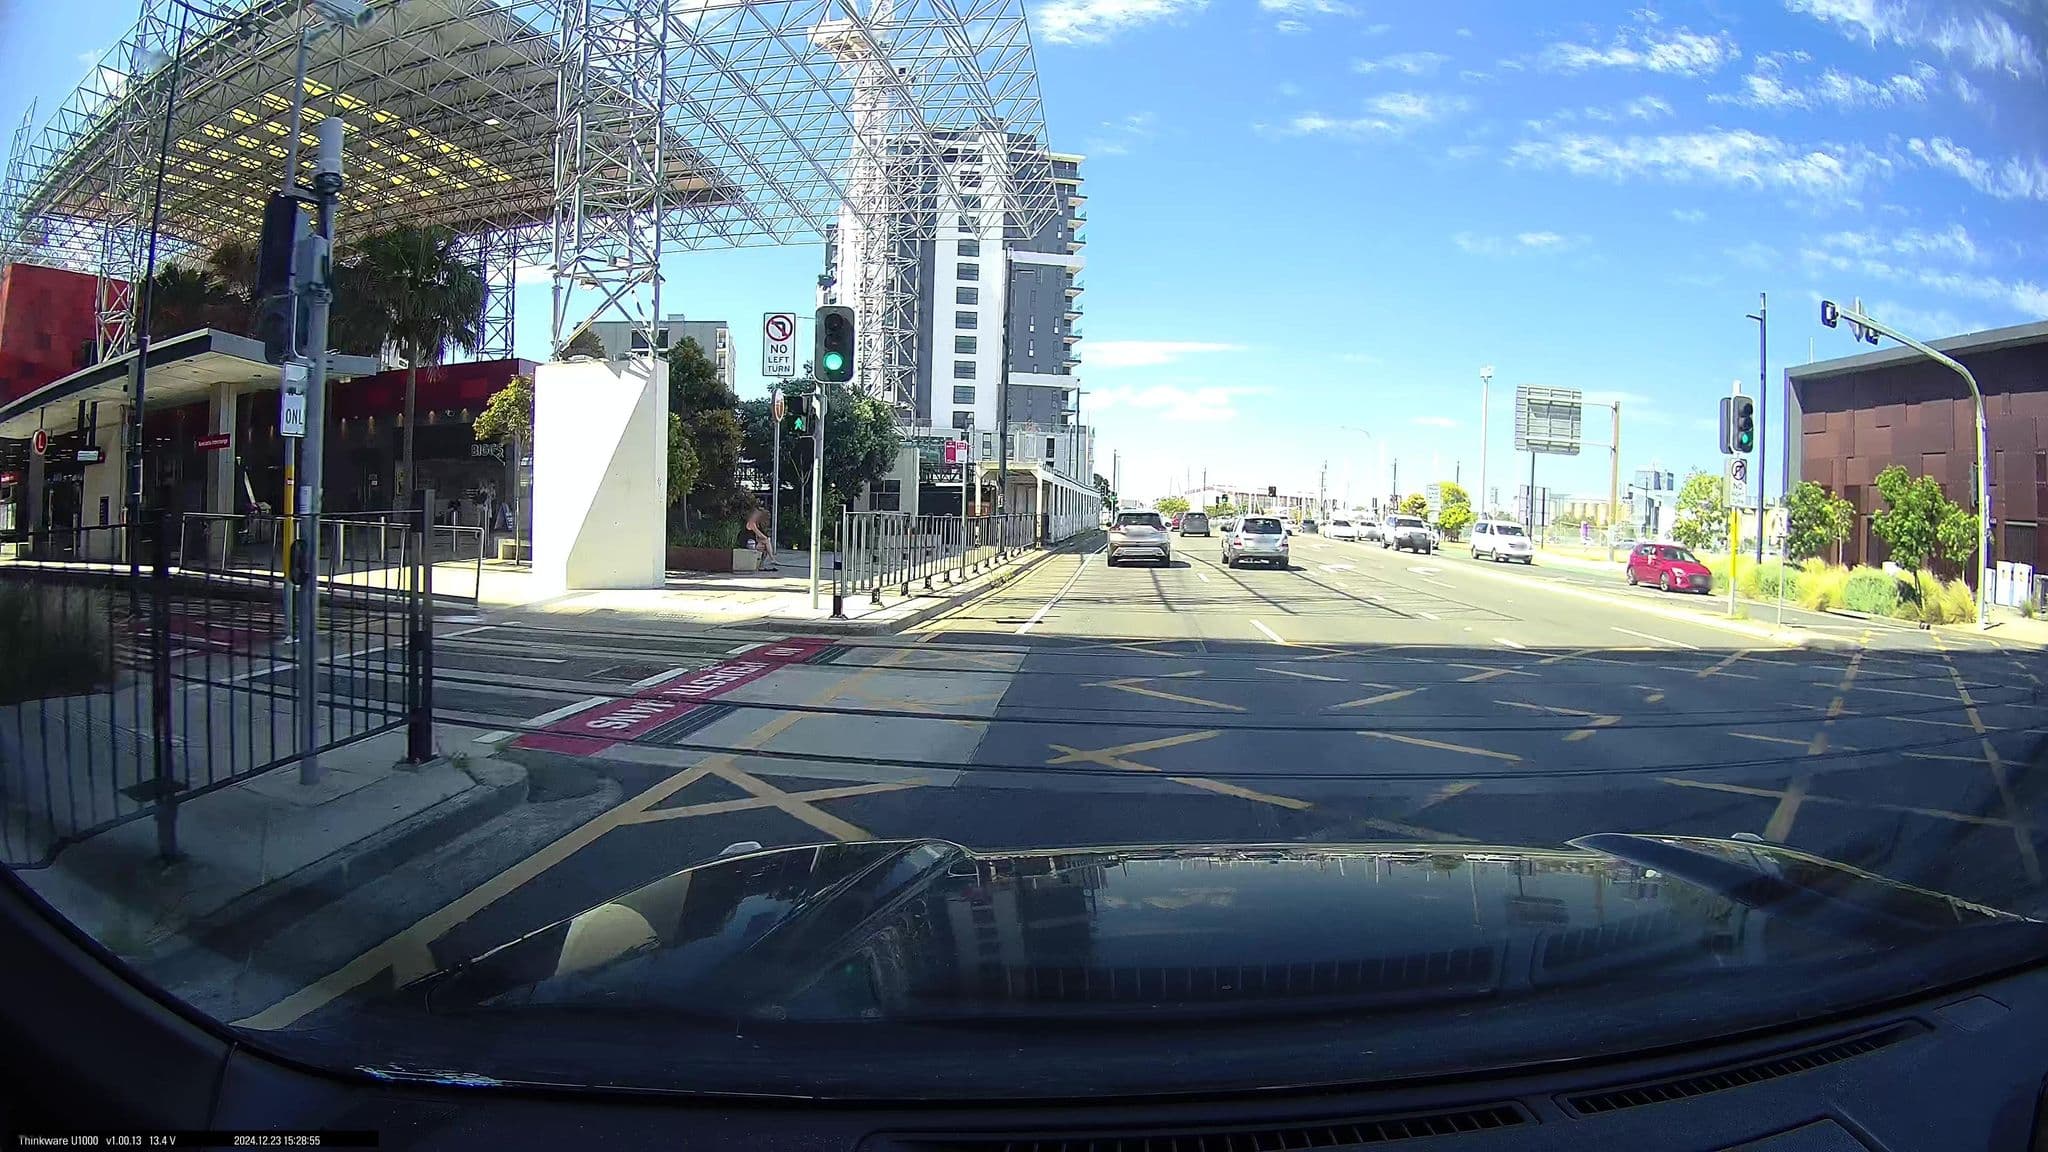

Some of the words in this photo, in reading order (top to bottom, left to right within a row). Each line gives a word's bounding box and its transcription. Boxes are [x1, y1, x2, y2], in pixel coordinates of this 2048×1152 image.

[770, 344, 788, 354] NO
[768, 365, 790, 373] TURN
[285, 408, 303, 425] ONL
